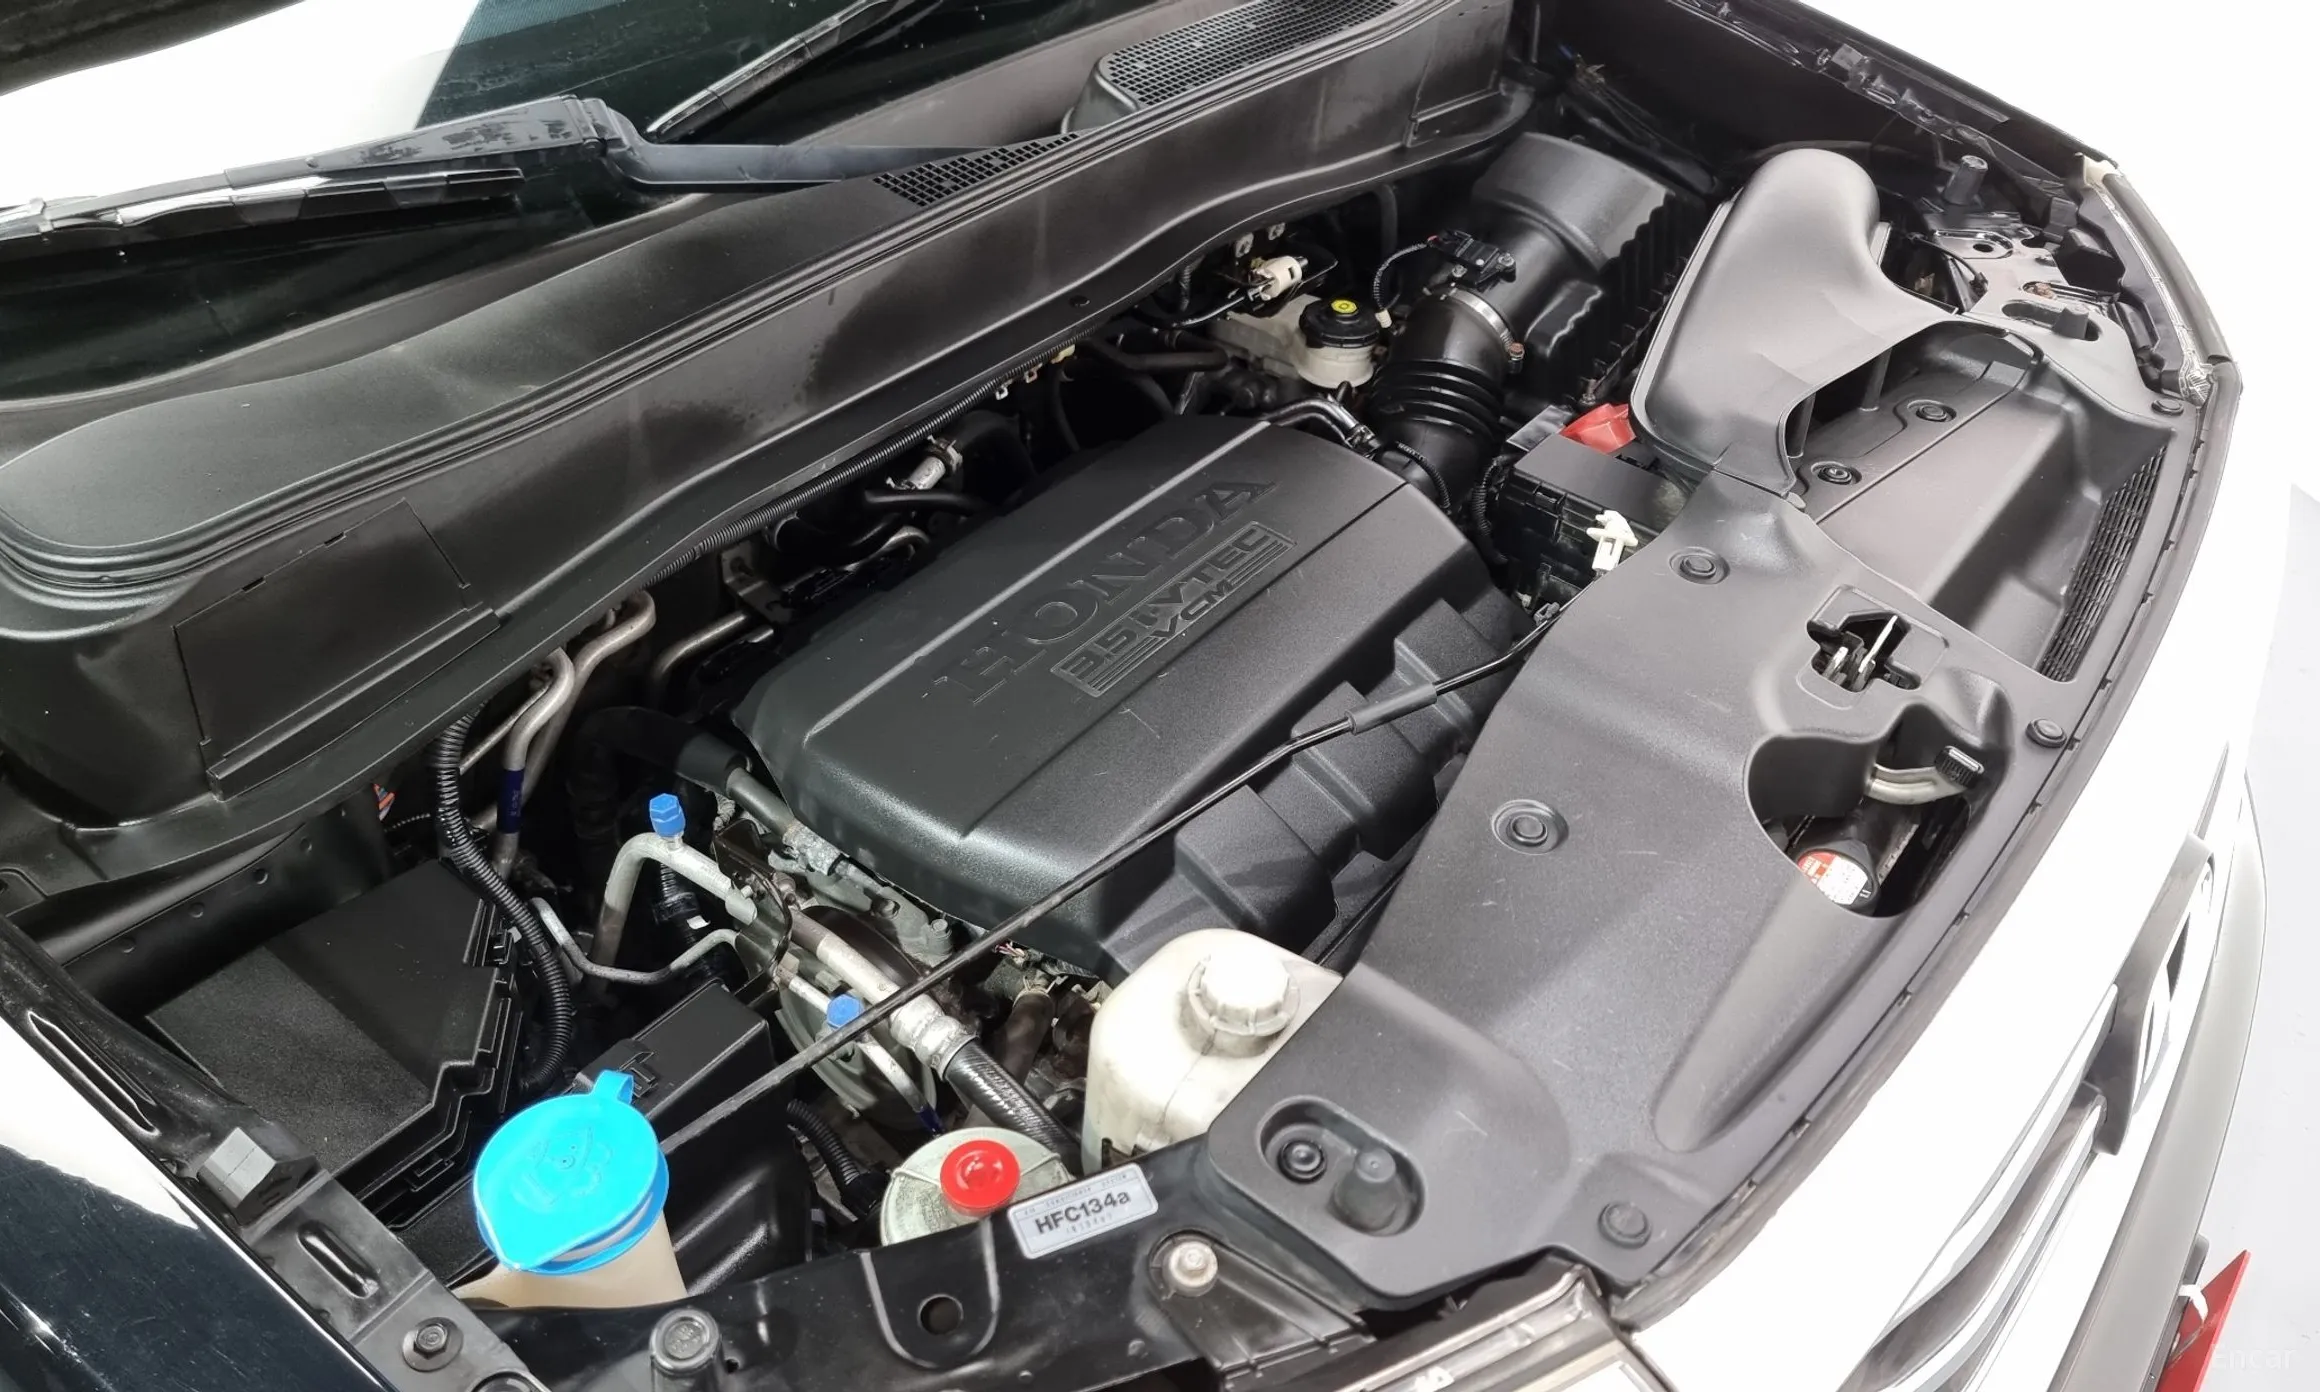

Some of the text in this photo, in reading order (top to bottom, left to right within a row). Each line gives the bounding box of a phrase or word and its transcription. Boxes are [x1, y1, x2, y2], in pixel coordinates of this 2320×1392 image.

[933, 481, 1278, 704] HONDA
[1150, 579, 1234, 638] VCM
[1034, 1189, 1131, 1235] HFC134a
